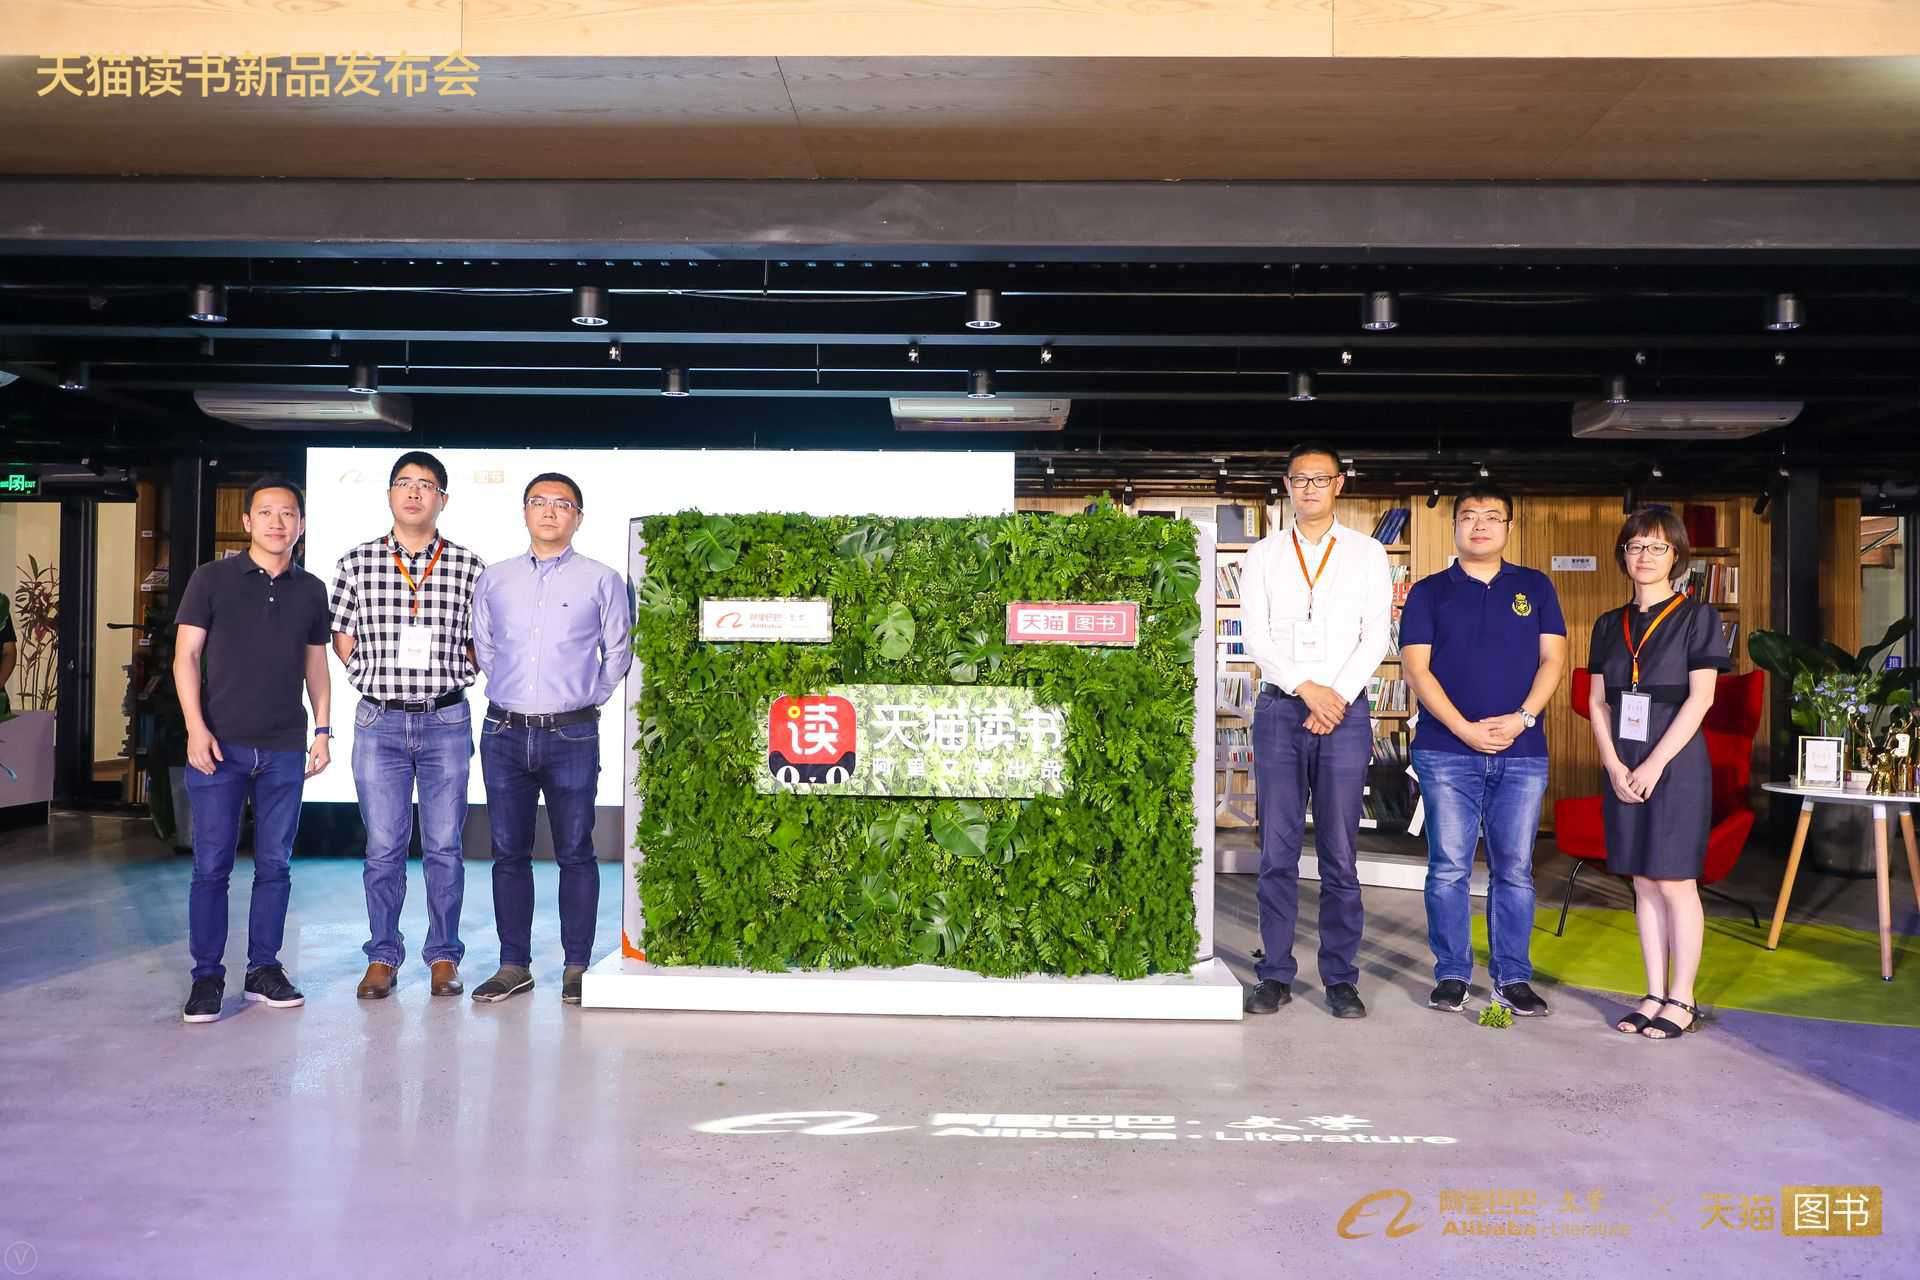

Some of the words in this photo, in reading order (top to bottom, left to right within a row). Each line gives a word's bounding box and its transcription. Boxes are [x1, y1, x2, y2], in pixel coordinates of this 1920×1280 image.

[1022, 611, 1065, 631] 天猫
[1074, 614, 1117, 633] 图书
[786, 703, 839, 756] 读
[872, 702, 1062, 754] 天猫读书
[1215, 1131, 1458, 1144] Literature
